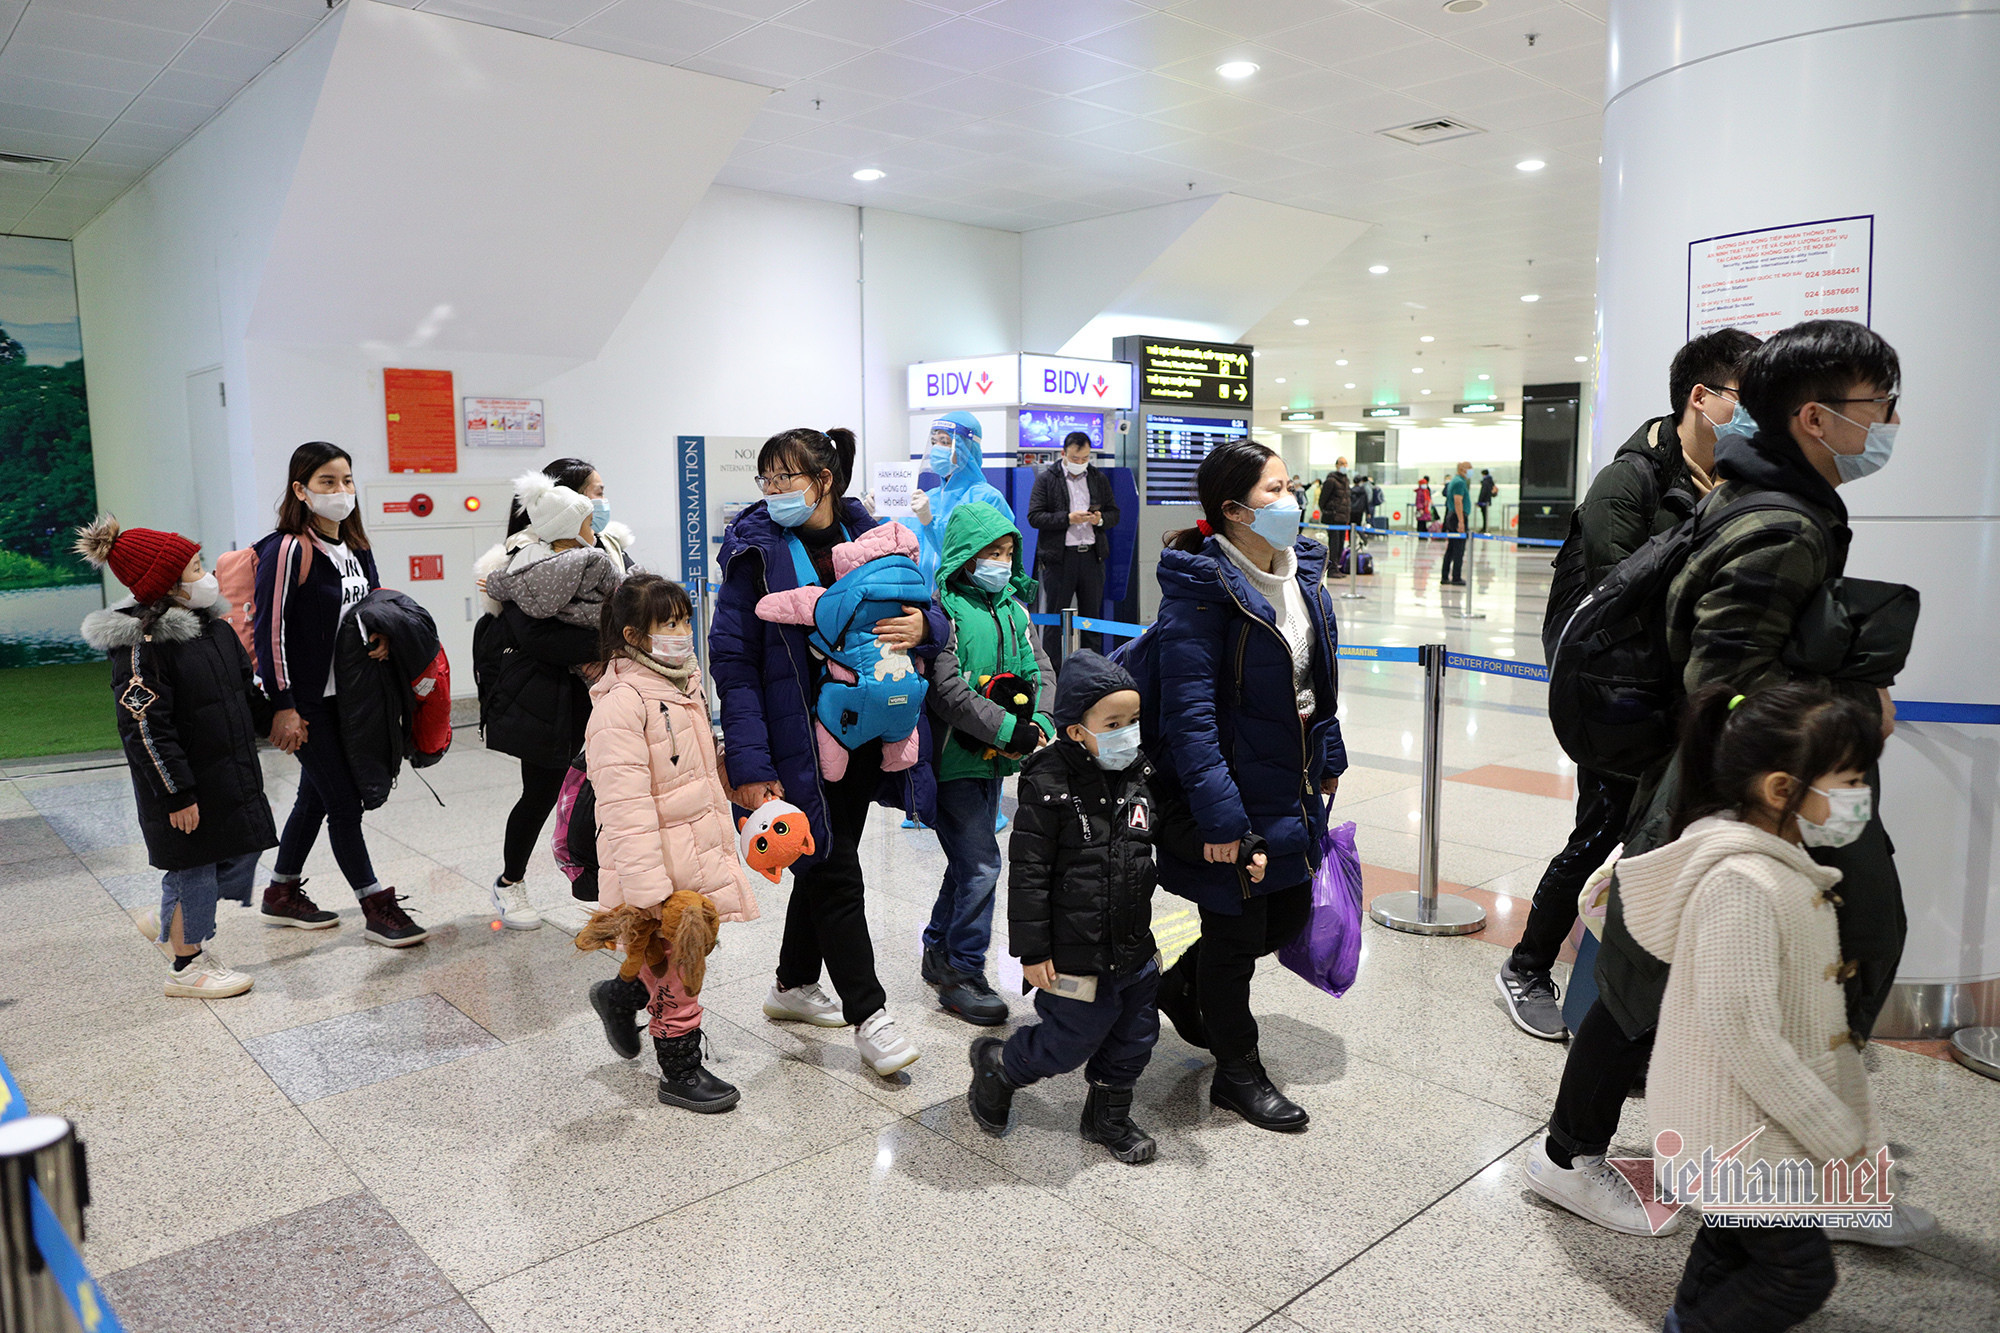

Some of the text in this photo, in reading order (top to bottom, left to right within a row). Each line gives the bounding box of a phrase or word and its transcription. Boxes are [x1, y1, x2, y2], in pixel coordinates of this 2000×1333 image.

[1822, 267, 1860, 276] 38843241
[1805, 290, 1819, 298] 024
[1804, 305, 1859, 317] 024 38866538
[927, 371, 972, 396] BIDV
[1044, 369, 1089, 395] BIDV
[735, 449, 755, 460] NOI
[685, 440, 701, 560] INFORMATION
[1339, 647, 1378, 657] QUARANTINE
[1448, 655, 1549, 679] CENTER FOR INTERNAT
[1130, 804, 1148, 829] A
